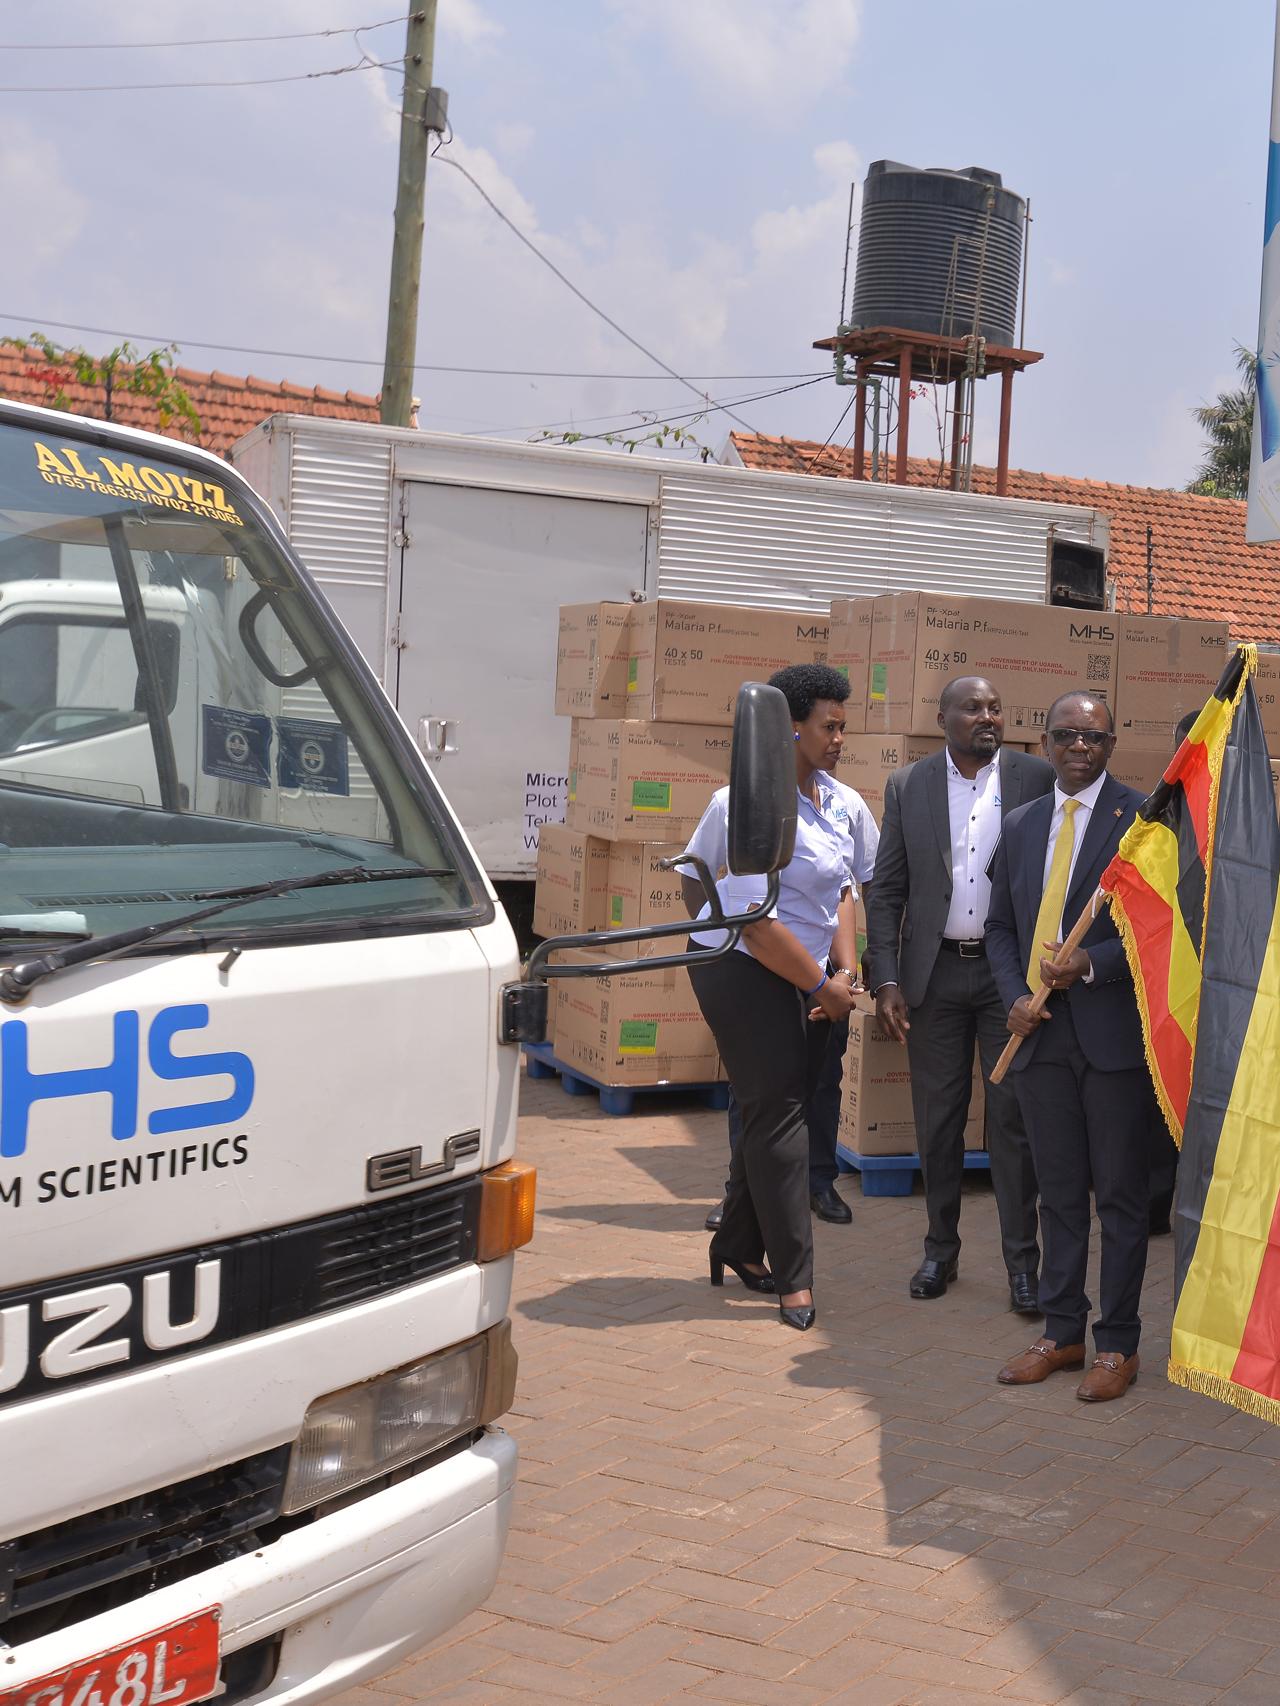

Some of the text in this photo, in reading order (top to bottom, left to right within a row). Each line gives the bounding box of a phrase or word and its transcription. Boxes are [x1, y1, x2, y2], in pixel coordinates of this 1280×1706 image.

[34, 441, 236, 514] AL MOIZZ
[41, 471, 85, 491] 0755
[192, 502, 245, 527] 213063
[664, 619, 705, 633] Malaria
[926, 616, 970, 632] Malaria
[973, 620, 988, 632] P.f
[1069, 623, 1115, 640] MHS
[1126, 634, 1150, 643] Malaria
[1200, 636, 1226, 646] MHS
[664, 648, 678, 659] 40
[681, 652, 688, 660] x
[690, 650, 703, 661] 50
[925, 649, 940, 662] 40
[943, 653, 950, 663] x
[953, 651, 967, 664] 50
[663, 658, 686, 667] TESTS
[924, 661, 949, 671] TESTS
[990, 657, 1029, 667] GOVERNMENT
[975, 661, 987, 669] FOR
[988, 662, 1009, 670] PUBLIC
[1010, 664, 1021, 672] USE
[1051, 667, 1062, 675] FOR
[1139, 670, 1175, 678] GOVERNMENT
[1265, 694, 1275, 704] 50
[628, 738, 651, 746] Malaria
[704, 739, 731, 748] MHS
[880, 749, 898, 764] MHS
[641, 770, 678, 778] GOVERNMENT
[525, 793, 557, 808] Plot
[832, 807, 848, 819] MHS
[650, 890, 663, 901] 40
[649, 900, 671, 909] TESTS
[619, 981, 643, 989] Malaria
[366, 1129, 481, 1193] ELF
[38, 1134, 249, 1204] SCIENTIFICS
